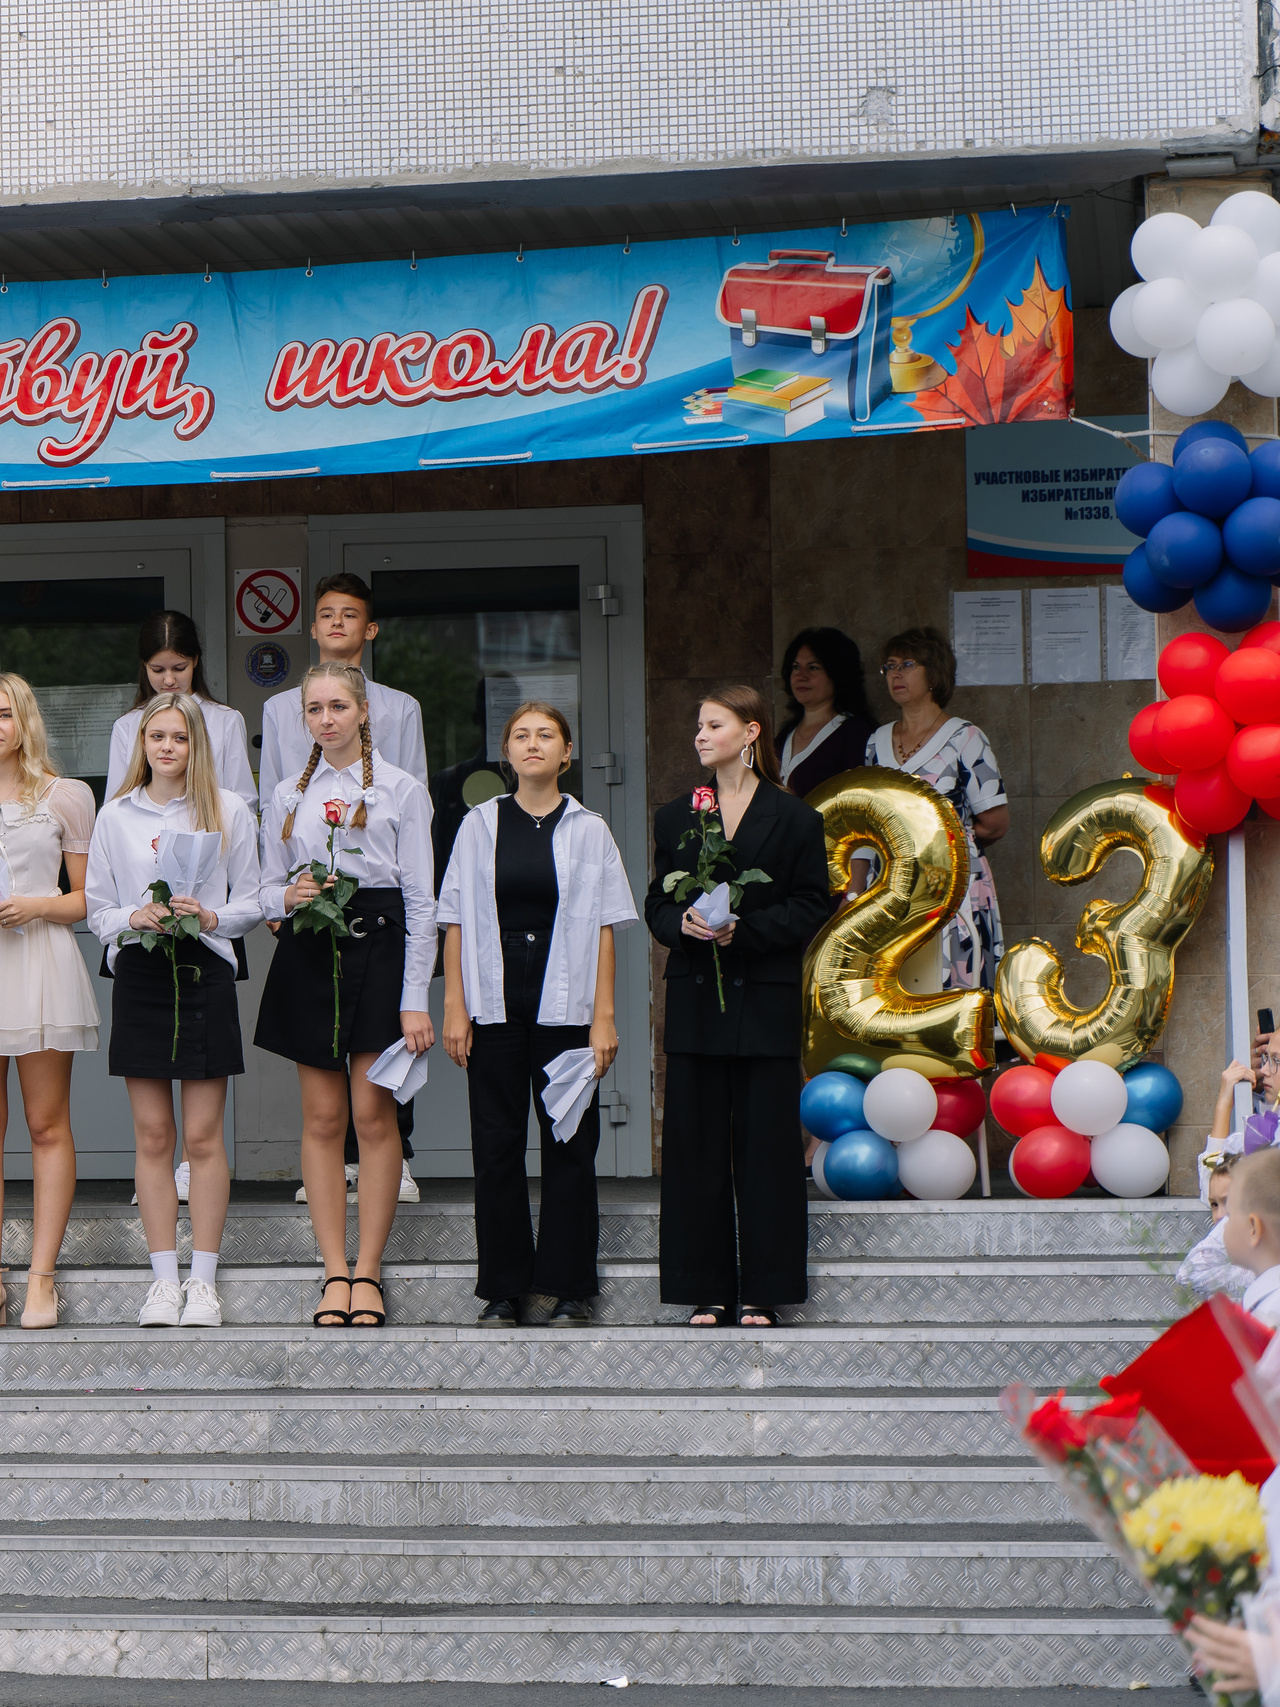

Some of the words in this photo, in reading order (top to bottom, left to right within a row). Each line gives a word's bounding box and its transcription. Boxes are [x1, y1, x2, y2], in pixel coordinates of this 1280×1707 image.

[265, 283, 669, 414] школа!
[974, 470, 1060, 485] УЧАСТКОВЫЕ
[1064, 466, 1131, 483] ИЗБИРАТ
[1022, 486, 1117, 503] ИЗБИРАТЕЛЬН
[1065, 505, 1113, 520] №1338,
